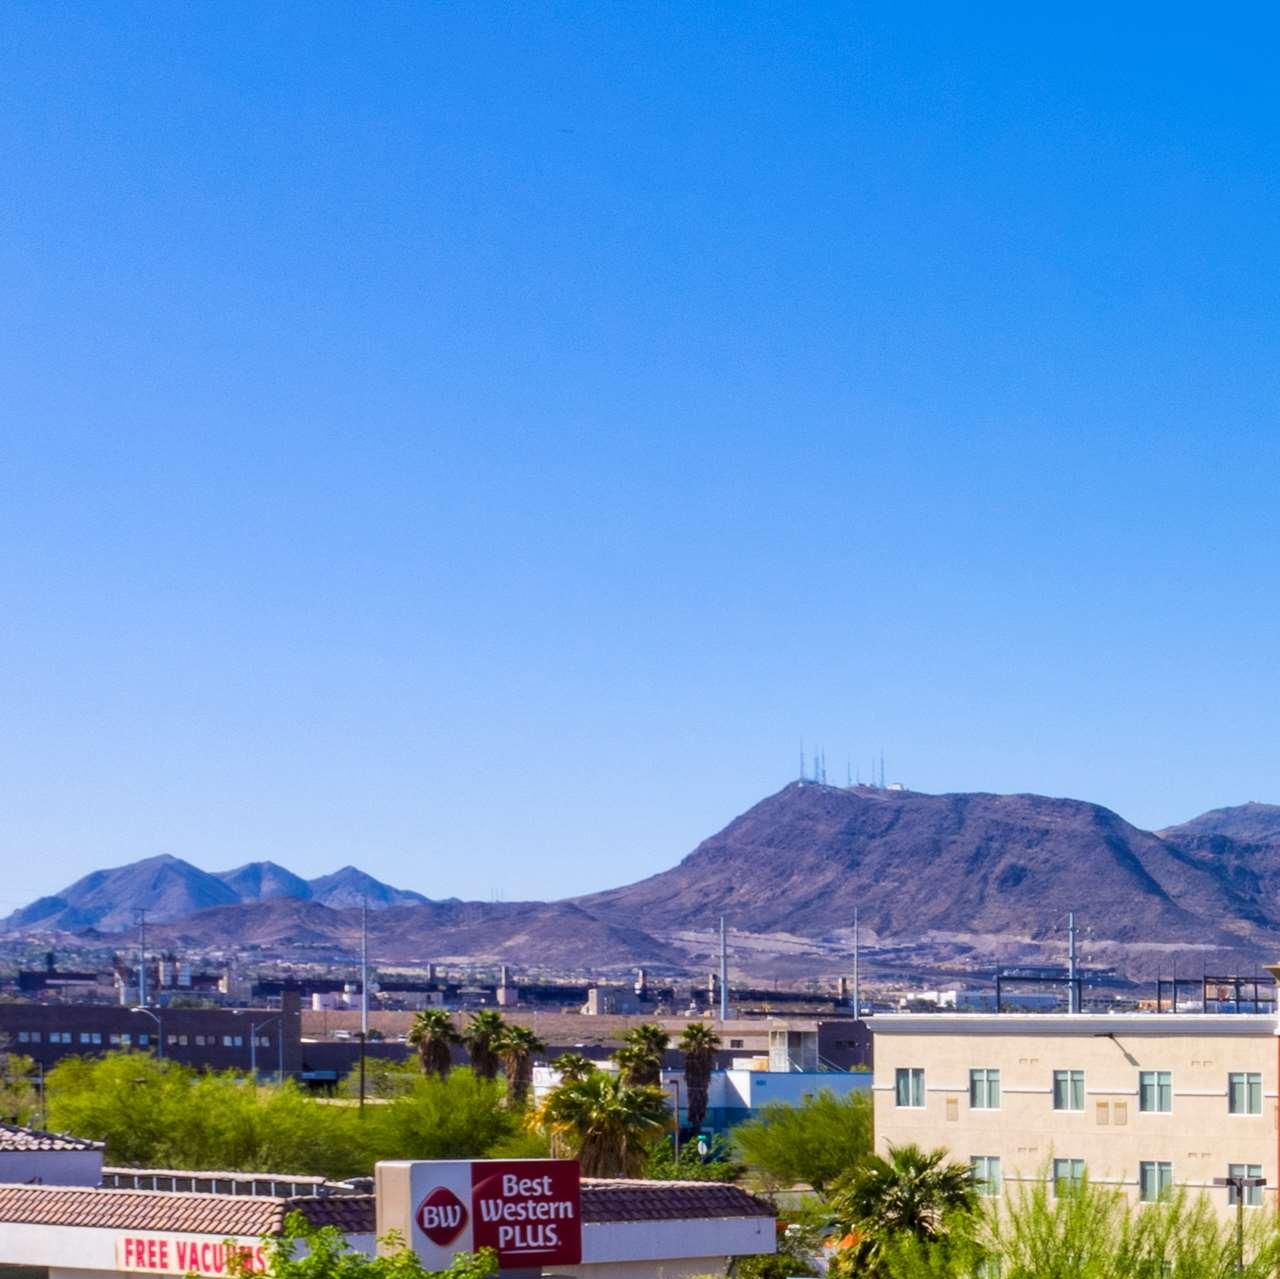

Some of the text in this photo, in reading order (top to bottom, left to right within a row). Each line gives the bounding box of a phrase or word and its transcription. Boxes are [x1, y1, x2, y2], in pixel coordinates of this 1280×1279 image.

[502, 1174, 553, 1197] Best
[423, 1206, 461, 1228] BW
[480, 1199, 574, 1222] Western
[124, 1238, 169, 1269] FREE
